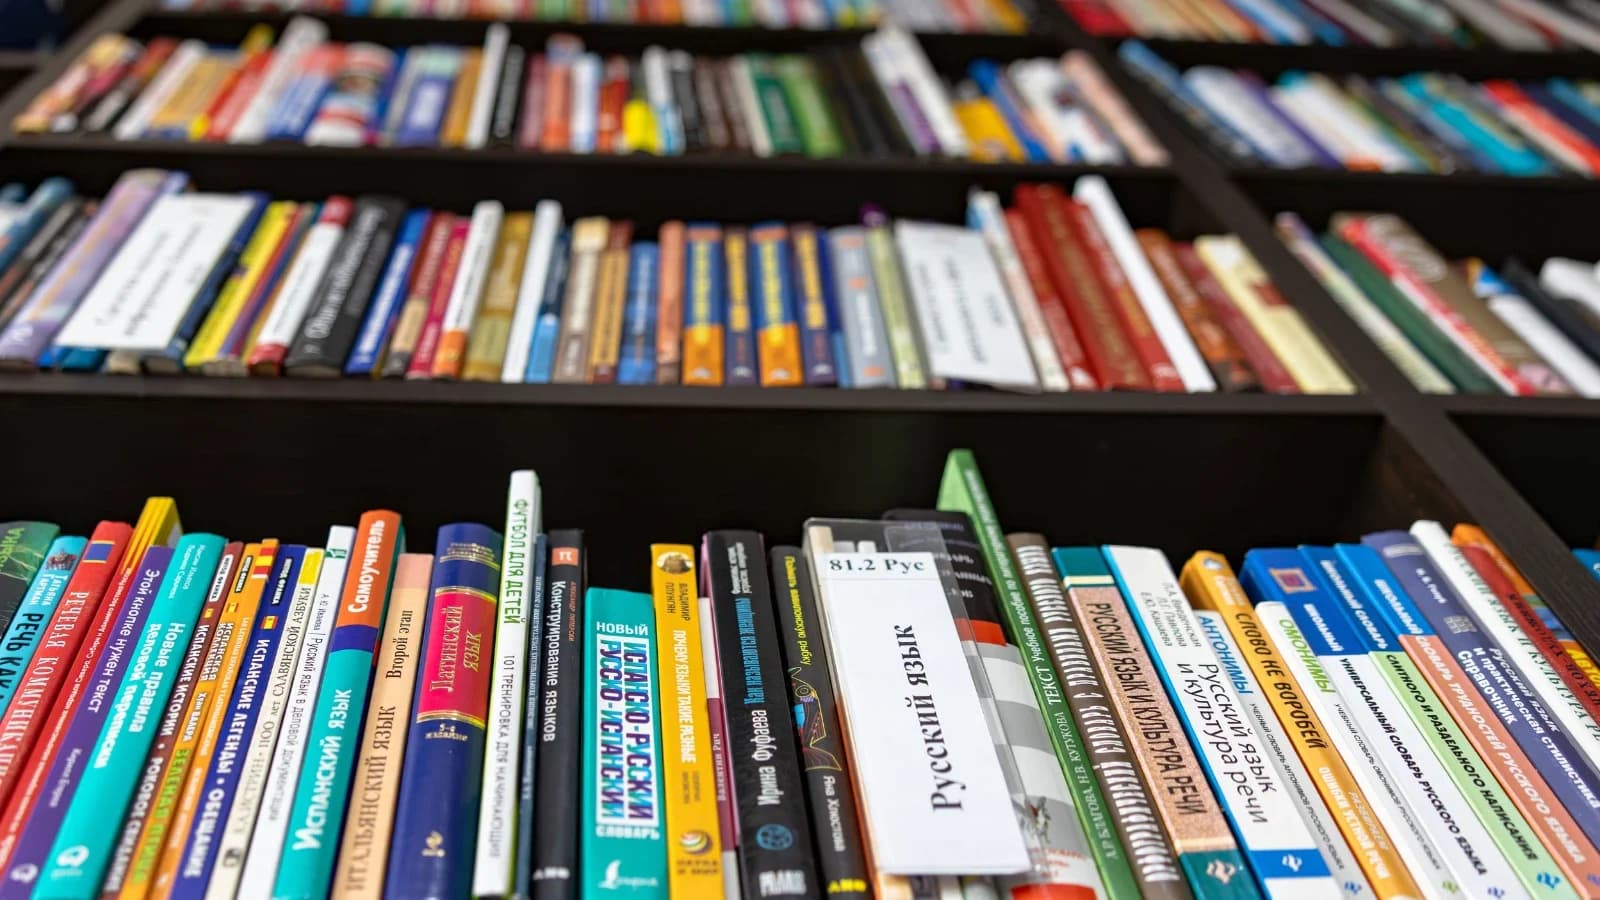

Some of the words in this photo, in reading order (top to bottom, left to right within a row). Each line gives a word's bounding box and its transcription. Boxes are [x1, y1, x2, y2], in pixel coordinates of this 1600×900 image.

[510, 499, 529, 547] ФУТБОЛ
[136, 569, 161, 594] Этой
[211, 576, 224, 599] ФРАНКА
[347, 520, 388, 613] Самоучитель
[507, 552, 525, 576] ДЛЯ
[830, 559, 876, 571] 81.2
[885, 559, 924, 574] Рус
[118, 597, 146, 635] кнопке
[273, 580, 285, 604] ФРАНКА
[291, 587, 311, 624] АЗБУКИ
[503, 580, 524, 623] ДЕТЕЙ
[664, 582, 676, 615] ПЛУНГЯН
[677, 583, 691, 623] ВЛАДИМИР
[789, 589, 808, 639] вавилонскую
[1009, 591, 1033, 625] пособие
[1372, 579, 1424, 636] ШКОЛЬНЫЙ
[4, 613, 45, 651] РЕЧЬ
[44, 592, 90, 647] РЕЧЕВАЯ
[152, 622, 185, 666] Новые
[398, 609, 414, 634] этап
[546, 581, 566, 685] Конструирование
[597, 622, 648, 636] НОВЫЙ
[1084, 602, 1133, 655] РУССКИЙ
[1302, 603, 1345, 652] ШКОЛЬНЫЙ
[1352, 610, 1391, 649] СЛОВАРЬ
[99, 639, 128, 675] нужен
[127, 623, 162, 680] деловой
[180, 625, 209, 681] ИСПАНСКИЕ
[197, 624, 225, 681] КОЛЛЕКЦИЯ
[206, 624, 233, 681] ИСПАНСКАЯ
[269, 626, 300, 697] СЛАВЯНСКОЙ
[301, 637, 323, 672] Русский
[386, 637, 412, 678] Второй
[428, 607, 466, 693] Латинский
[503, 656, 515, 671] 101
[672, 630, 689, 663] ПОЧЕМУ
[738, 636, 763, 685] называются
[797, 640, 813, 666] рыбку
[892, 623, 929, 687] язык
[1021, 628, 1046, 662] Учебное
[1048, 628, 1100, 685] ПРАВИЛАМИ
[1175, 662, 1196, 674] и
[1197, 616, 1254, 694] АНТОНИМЫ
[1276, 618, 1337, 694] ОМОНИМЫ
[1472, 647, 1489, 656] и
[1484, 599, 1521, 633] ЯЗЫК
[1515, 637, 1532, 646] И
[1525, 651, 1588, 720] КУЛЬТУРА
[87, 679, 112, 712] текст
[237, 639, 271, 710] ИСПАНСКИЕ
[297, 674, 313, 696] язык
[675, 663, 691, 694] ЯЗЫКИ
[743, 687, 765, 705] Как
[1035, 666, 1063, 705] ТЕКСТ
[1109, 658, 1151, 691] ЯЗЫК
[1125, 695, 1157, 703] И
[1233, 613, 1274, 656] СЛОВО
[1260, 660, 1285, 677] НЕ
[1273, 682, 1329, 750] ВОРОБЕЙ
[1456, 649, 1520, 727] Справочник
[1478, 657, 1546, 735] практическая
[1487, 648, 1534, 698] Русский
[1528, 700, 1561, 734] язык
[91, 685, 136, 767] переписки
[125, 671, 165, 732] правила
[160, 684, 189, 736] ИСТОРИИ
[270, 701, 281, 716] лет
[498, 674, 513, 738] ТРЕНИРОВКА
[543, 691, 558, 741] языков
[677, 694, 693, 724] ТАКИЕ
[1179, 679, 1239, 765] культура
[214, 713, 248, 773] ЛЕГЕНДЫ
[284, 708, 306, 746] деловой
[496, 741, 508, 762] ДЛЯ
[678, 725, 696, 763] РАЗНЫЕ
[749, 709, 779, 762] Фуфаева
[1053, 711, 1083, 762] КУТУКОВА
[1078, 704, 1127, 754] СЛОВАРЬ
[1130, 707, 1188, 772] КУЛЬТУРА
[1195, 662, 1253, 736] Русский
[1236, 742, 1278, 795] язык
[1413, 636, 1457, 680] СЛОВАРЬ
[1445, 683, 1507, 750] ТРУДНОСТЕЙ
[1496, 752, 1552, 814] РУССКОГО
[1543, 816, 1586, 862] ЯЗЫКА
[904, 694, 968, 814] Русский
[1248, 704, 1272, 732] УЧЕБНЫЙ
[1264, 734, 1289, 763] СЛОВАРЬ
[1281, 765, 1311, 805] АНТОНИМОВ
[1304, 807, 1331, 842] РУССКОГО
[1332, 703, 1358, 733] УЧЕБНЫЙ
[1352, 735, 1377, 764] СЛОВАРЬ
[1372, 766, 1402, 805] ОМОНИМОВ
[1337, 658, 1397, 733] УНИВЕРСАЛЬНЫЙ
[1387, 735, 1425, 779] СЛОВАРЬ
[1418, 780, 1462, 834] РУССКОГО
[1454, 836, 1489, 875] ЯЗЫКА
[1384, 654, 1429, 703] СЛИТНОГО
[1424, 715, 1487, 788] РАЗДЕЛЬНОГО
[1477, 790, 1540, 860] НАПИСАНИЯ
[1539, 736, 1600, 809] стилистика
[343, 756, 388, 892] ИТАЛЬЯНСКИЙ
[372, 707, 395, 749] ЯЗЫК
[756, 766, 784, 806] Ирина
[823, 775, 838, 796] Яна
[1162, 777, 1208, 816] РЕЧИ
[1222, 770, 1269, 826] речи
[181, 789, 226, 878] ОБЕЩАНИЕ
[596, 825, 661, 841] СЛОВАРЬ
[1316, 766, 1352, 808] ОШИБКИ
[1340, 811, 1381, 855] УСТНОЙ
[1366, 857, 1402, 894] РЕЧИ
